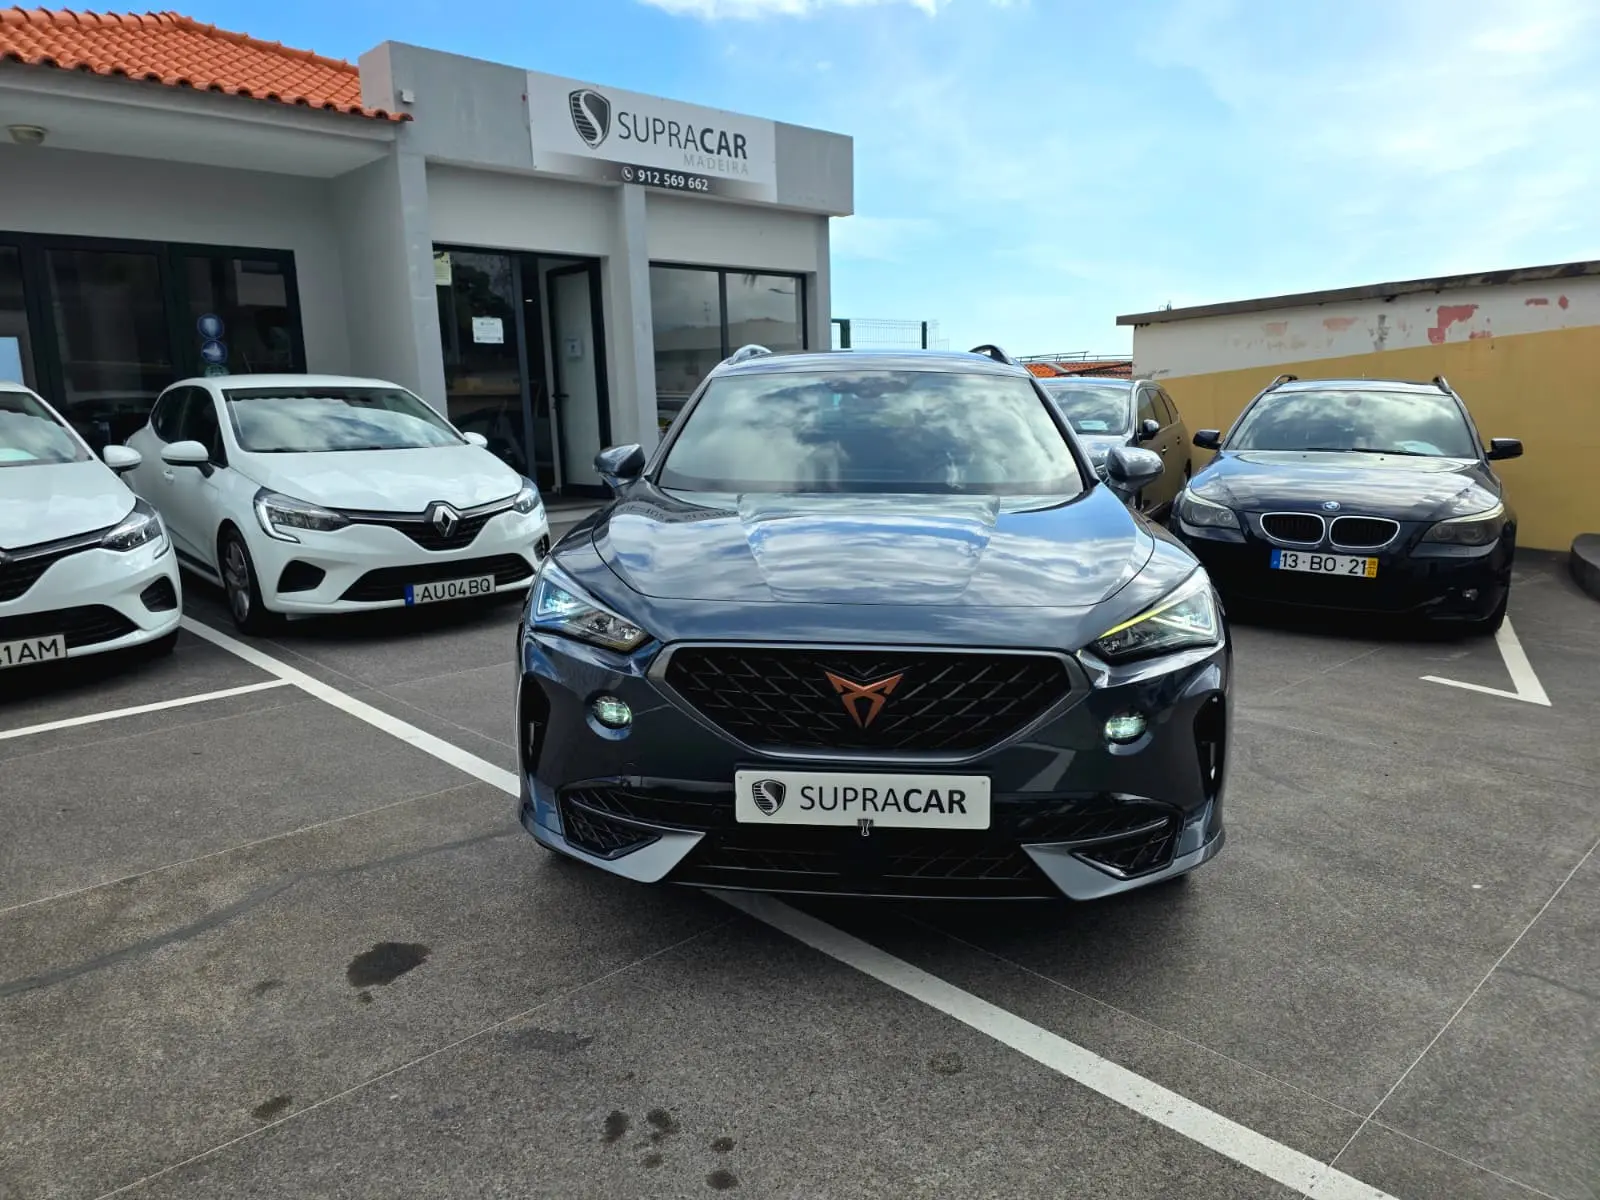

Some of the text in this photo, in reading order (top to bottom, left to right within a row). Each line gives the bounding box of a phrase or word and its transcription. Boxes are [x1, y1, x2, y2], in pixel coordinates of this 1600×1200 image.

[617, 111, 748, 160] SUPRACAR
[683, 152, 749, 176] MADEIRA
[638, 169, 708, 191] 912 569 662
[0, 638, 59, 665] 1AM
[800, 785, 967, 815] SUPRACAR
